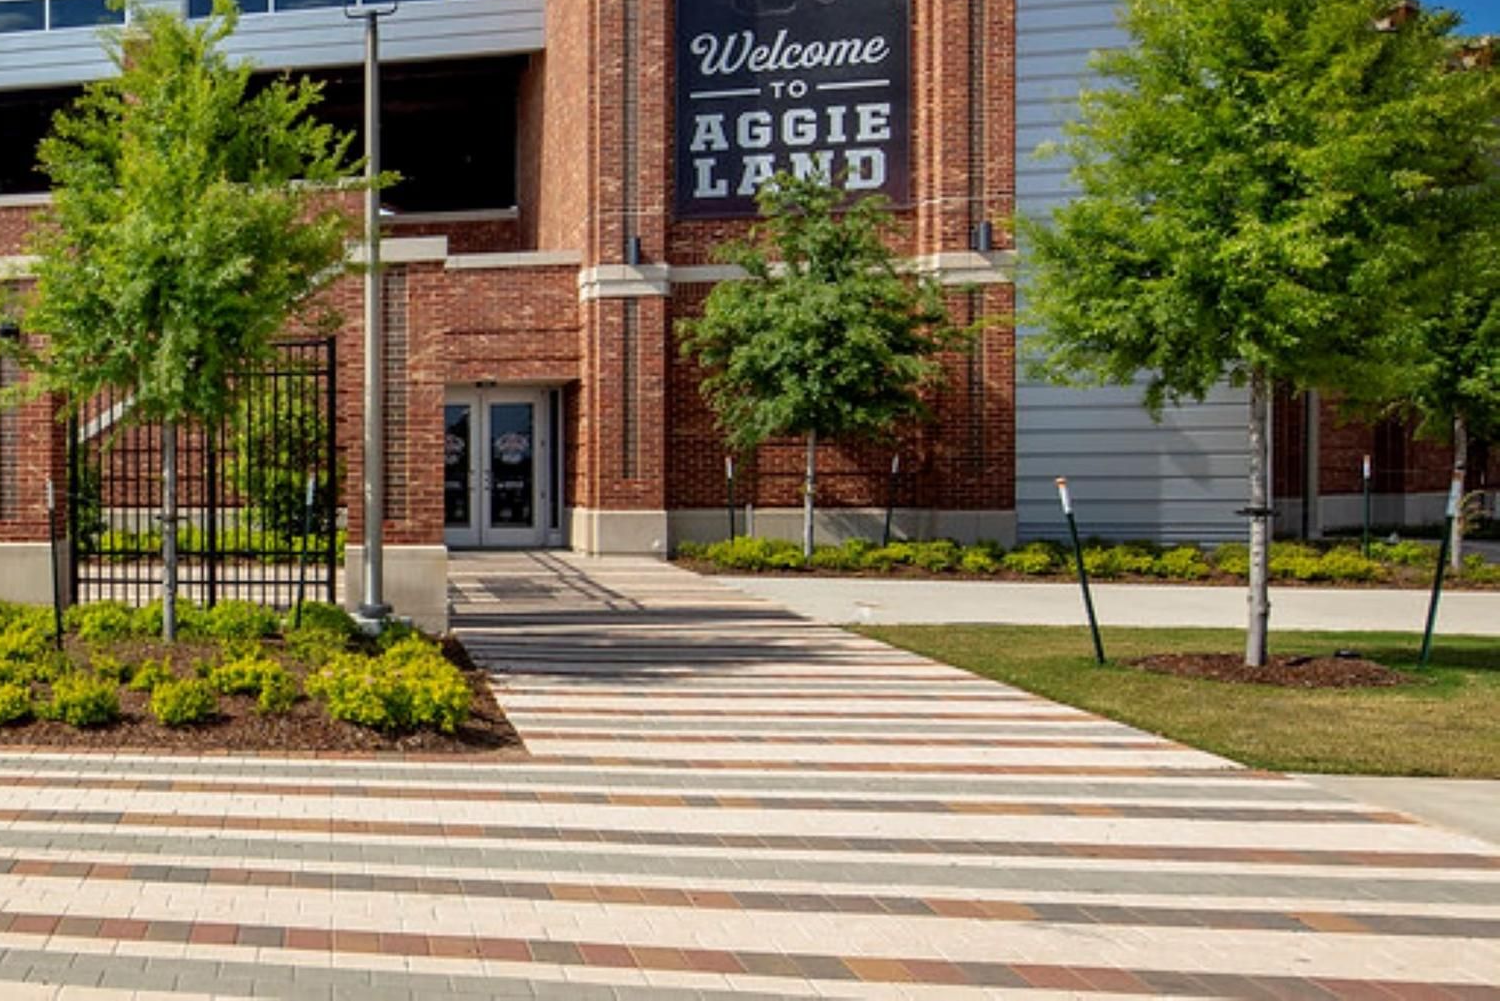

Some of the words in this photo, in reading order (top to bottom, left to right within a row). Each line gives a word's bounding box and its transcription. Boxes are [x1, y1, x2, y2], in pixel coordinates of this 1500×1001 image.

[690, 29, 890, 75] Welcome
[770, 79, 808, 98] TO
[689, 103, 890, 151] AGGIE
[693, 148, 885, 198] LAND
